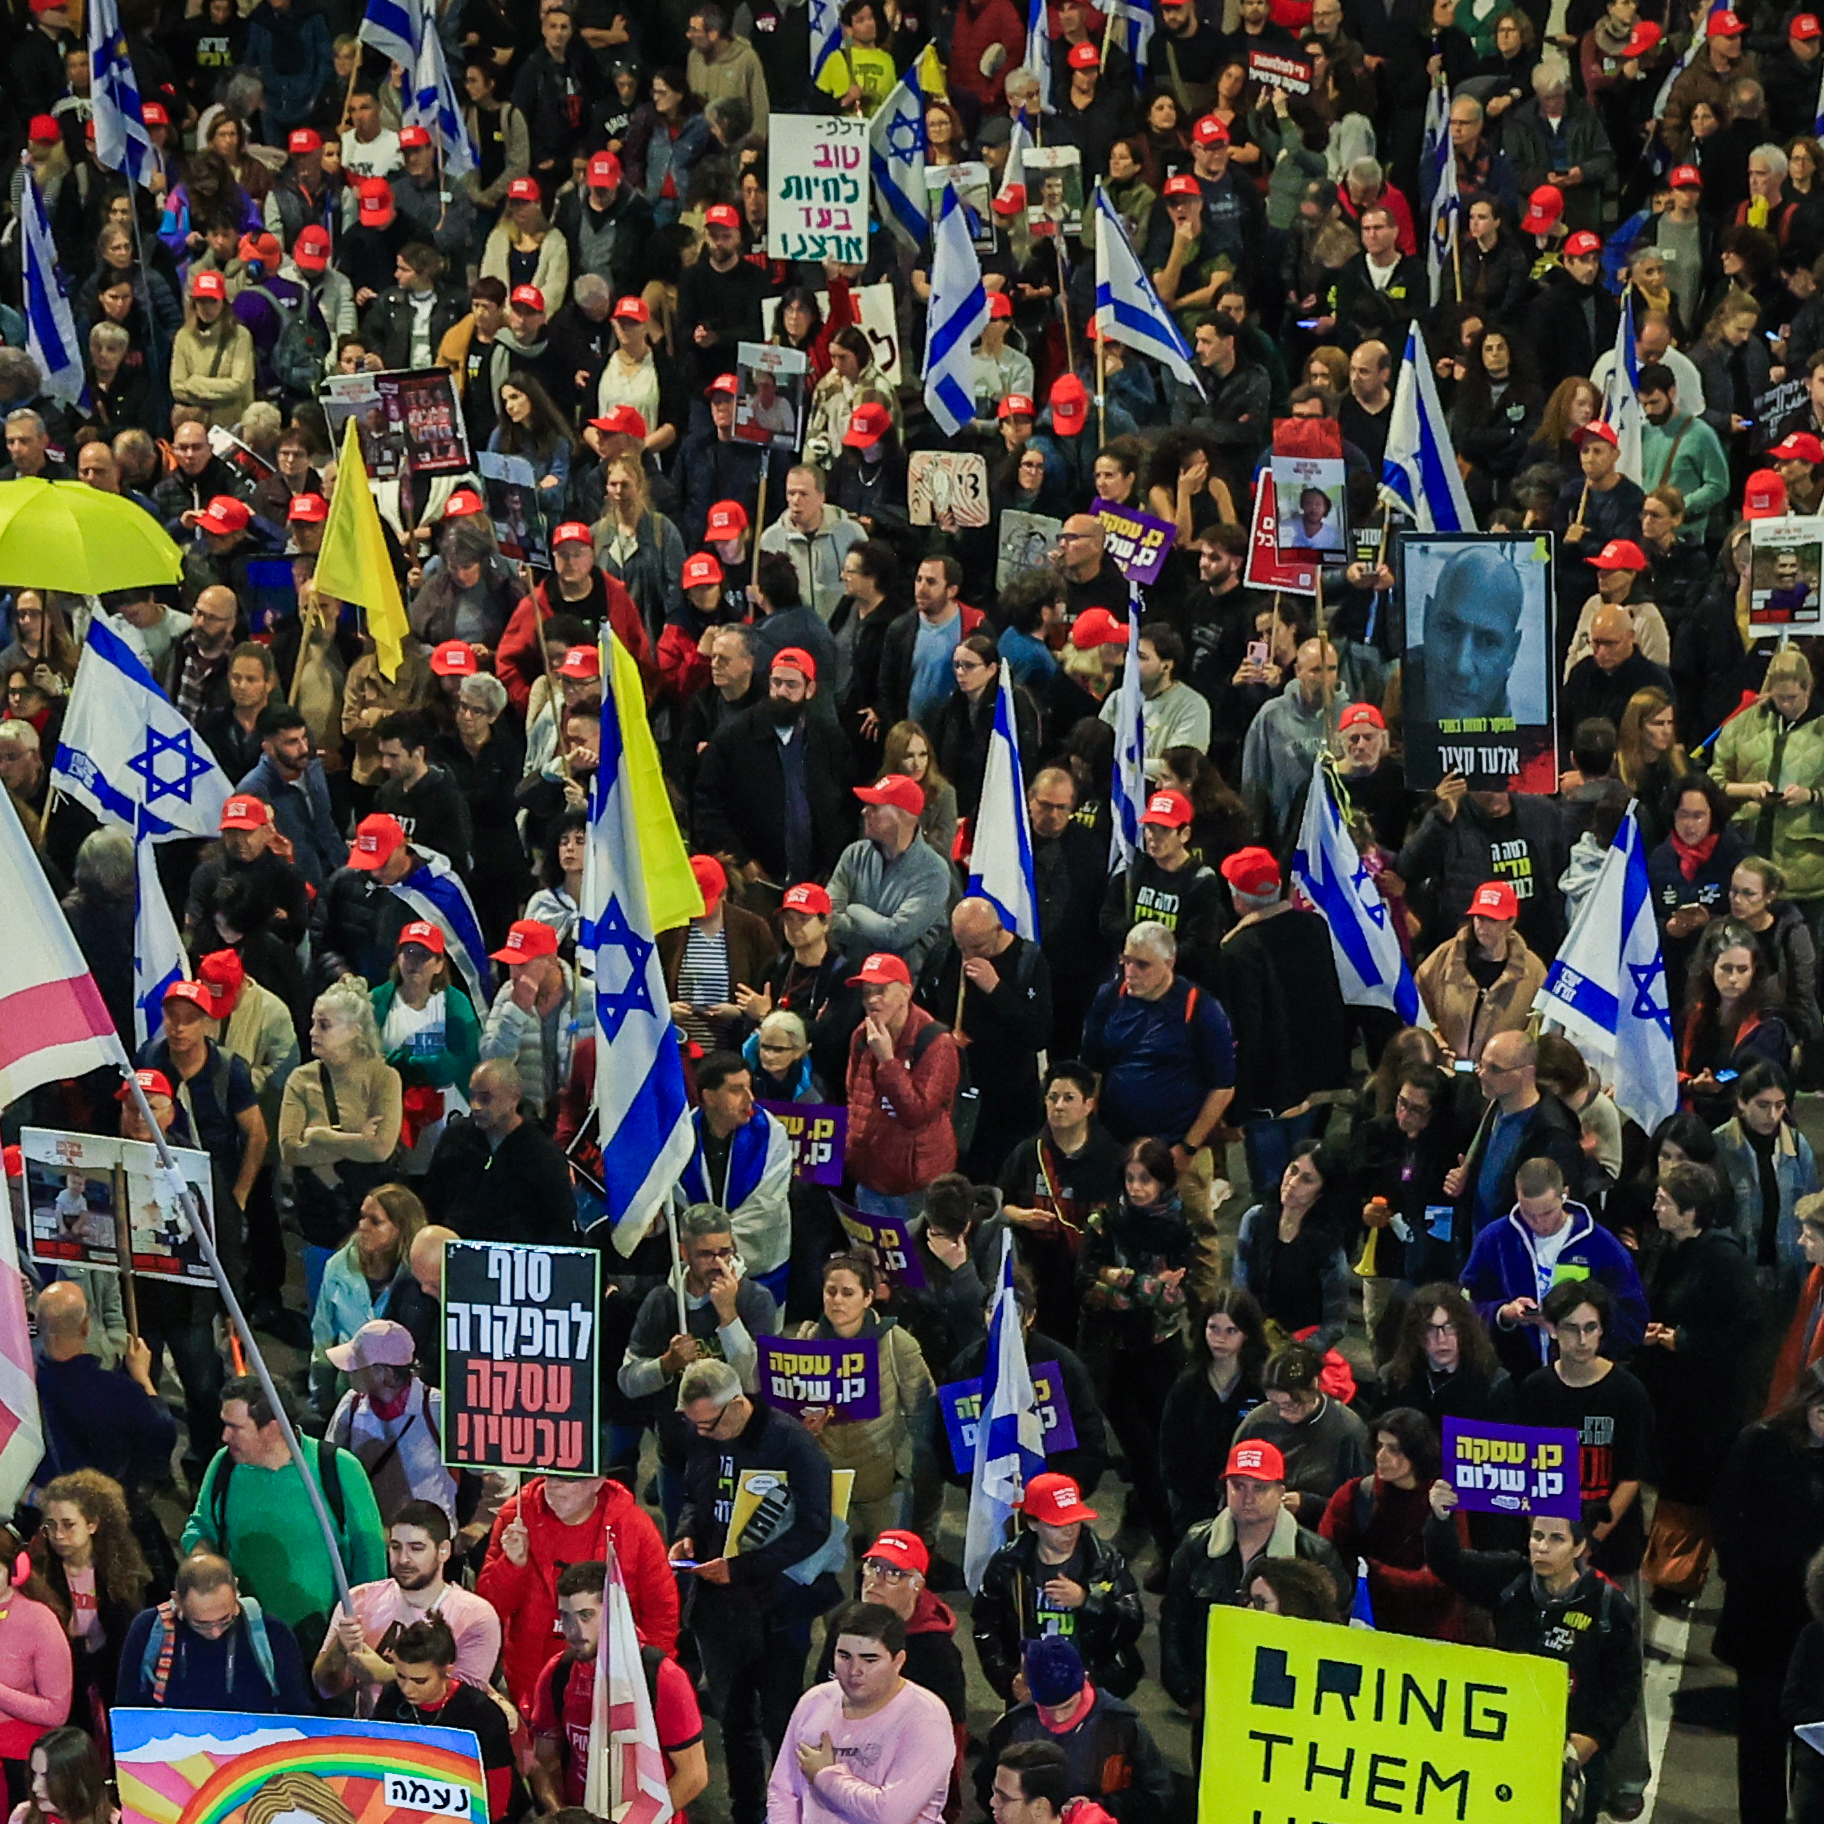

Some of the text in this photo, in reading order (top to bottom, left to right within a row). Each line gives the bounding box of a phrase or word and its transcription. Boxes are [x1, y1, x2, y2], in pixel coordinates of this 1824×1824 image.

[813, 143, 861, 169] טוב
[779, 173, 860, 204] לחיות
[799, 206, 853, 231] בעד
[781, 233, 864, 262] ארצנו
[1438, 746, 1519, 776] אלעד קציר
[486, 1248, 553, 1306] סוף
[445, 1302, 593, 1360] להפקרה
[769, 1352, 865, 1380] כן, עסקה
[466, 1359, 573, 1416] עסקה
[770, 1376, 867, 1404] כן, שלום
[456, 1412, 584, 1470] עכשיו!
[1457, 1436, 1563, 1470] כן, עסקה
[1457, 1463, 1564, 1498] כן, שלום
[1251, 1644, 1510, 1743] BRING
[1248, 1728, 1472, 1823] THEM
[392, 1780, 470, 1813] נעמה
